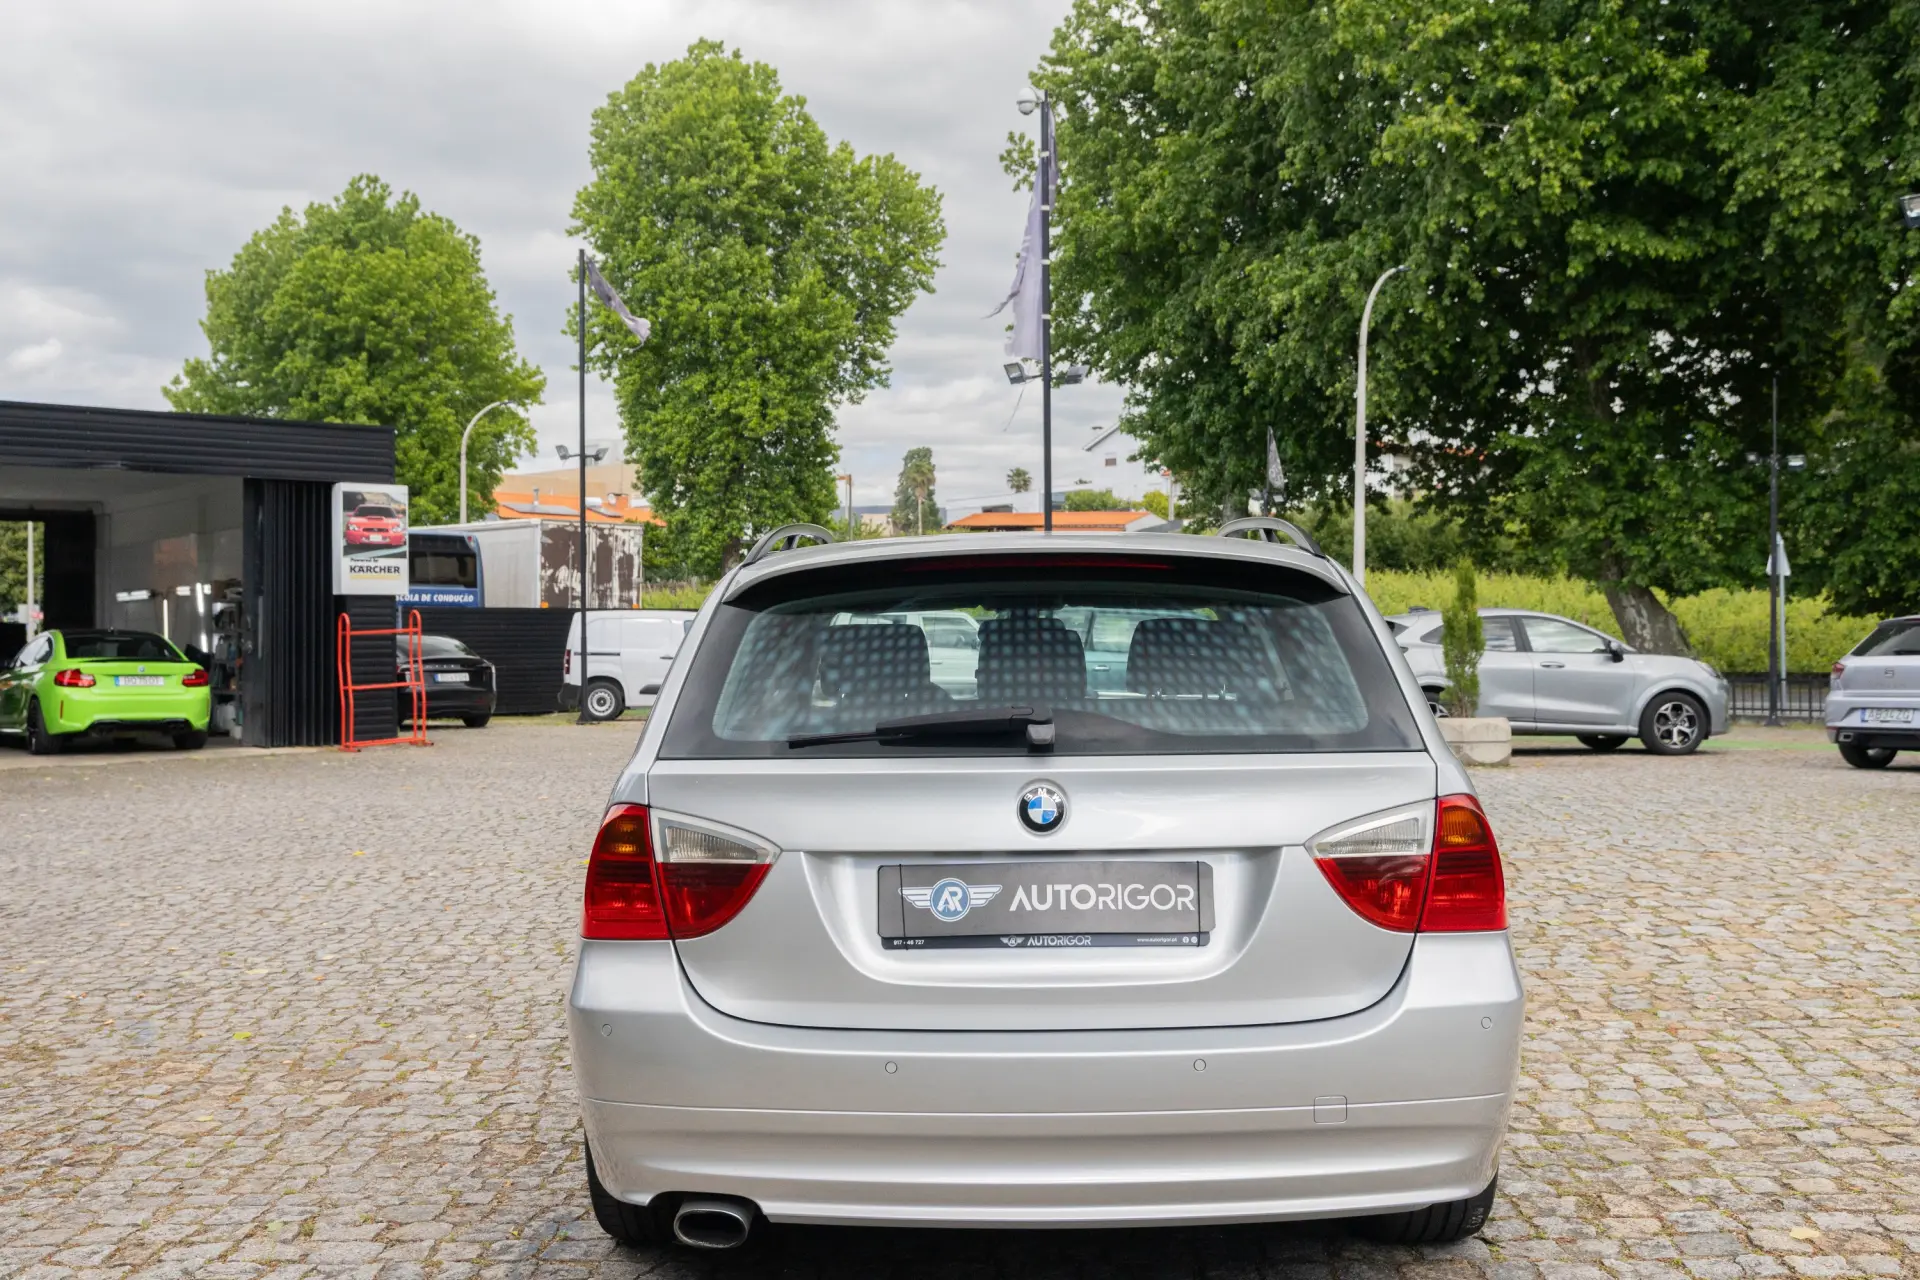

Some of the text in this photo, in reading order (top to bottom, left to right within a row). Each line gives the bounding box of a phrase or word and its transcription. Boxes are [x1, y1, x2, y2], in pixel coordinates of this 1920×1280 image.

[396, 592, 474, 603] SCOLA DE CONDUÇÃO
[1023, 787, 1062, 803] BMW
[1009, 883, 1196, 912] AUTORIGOR
[1027, 935, 1092, 946] AUTORIGOR
